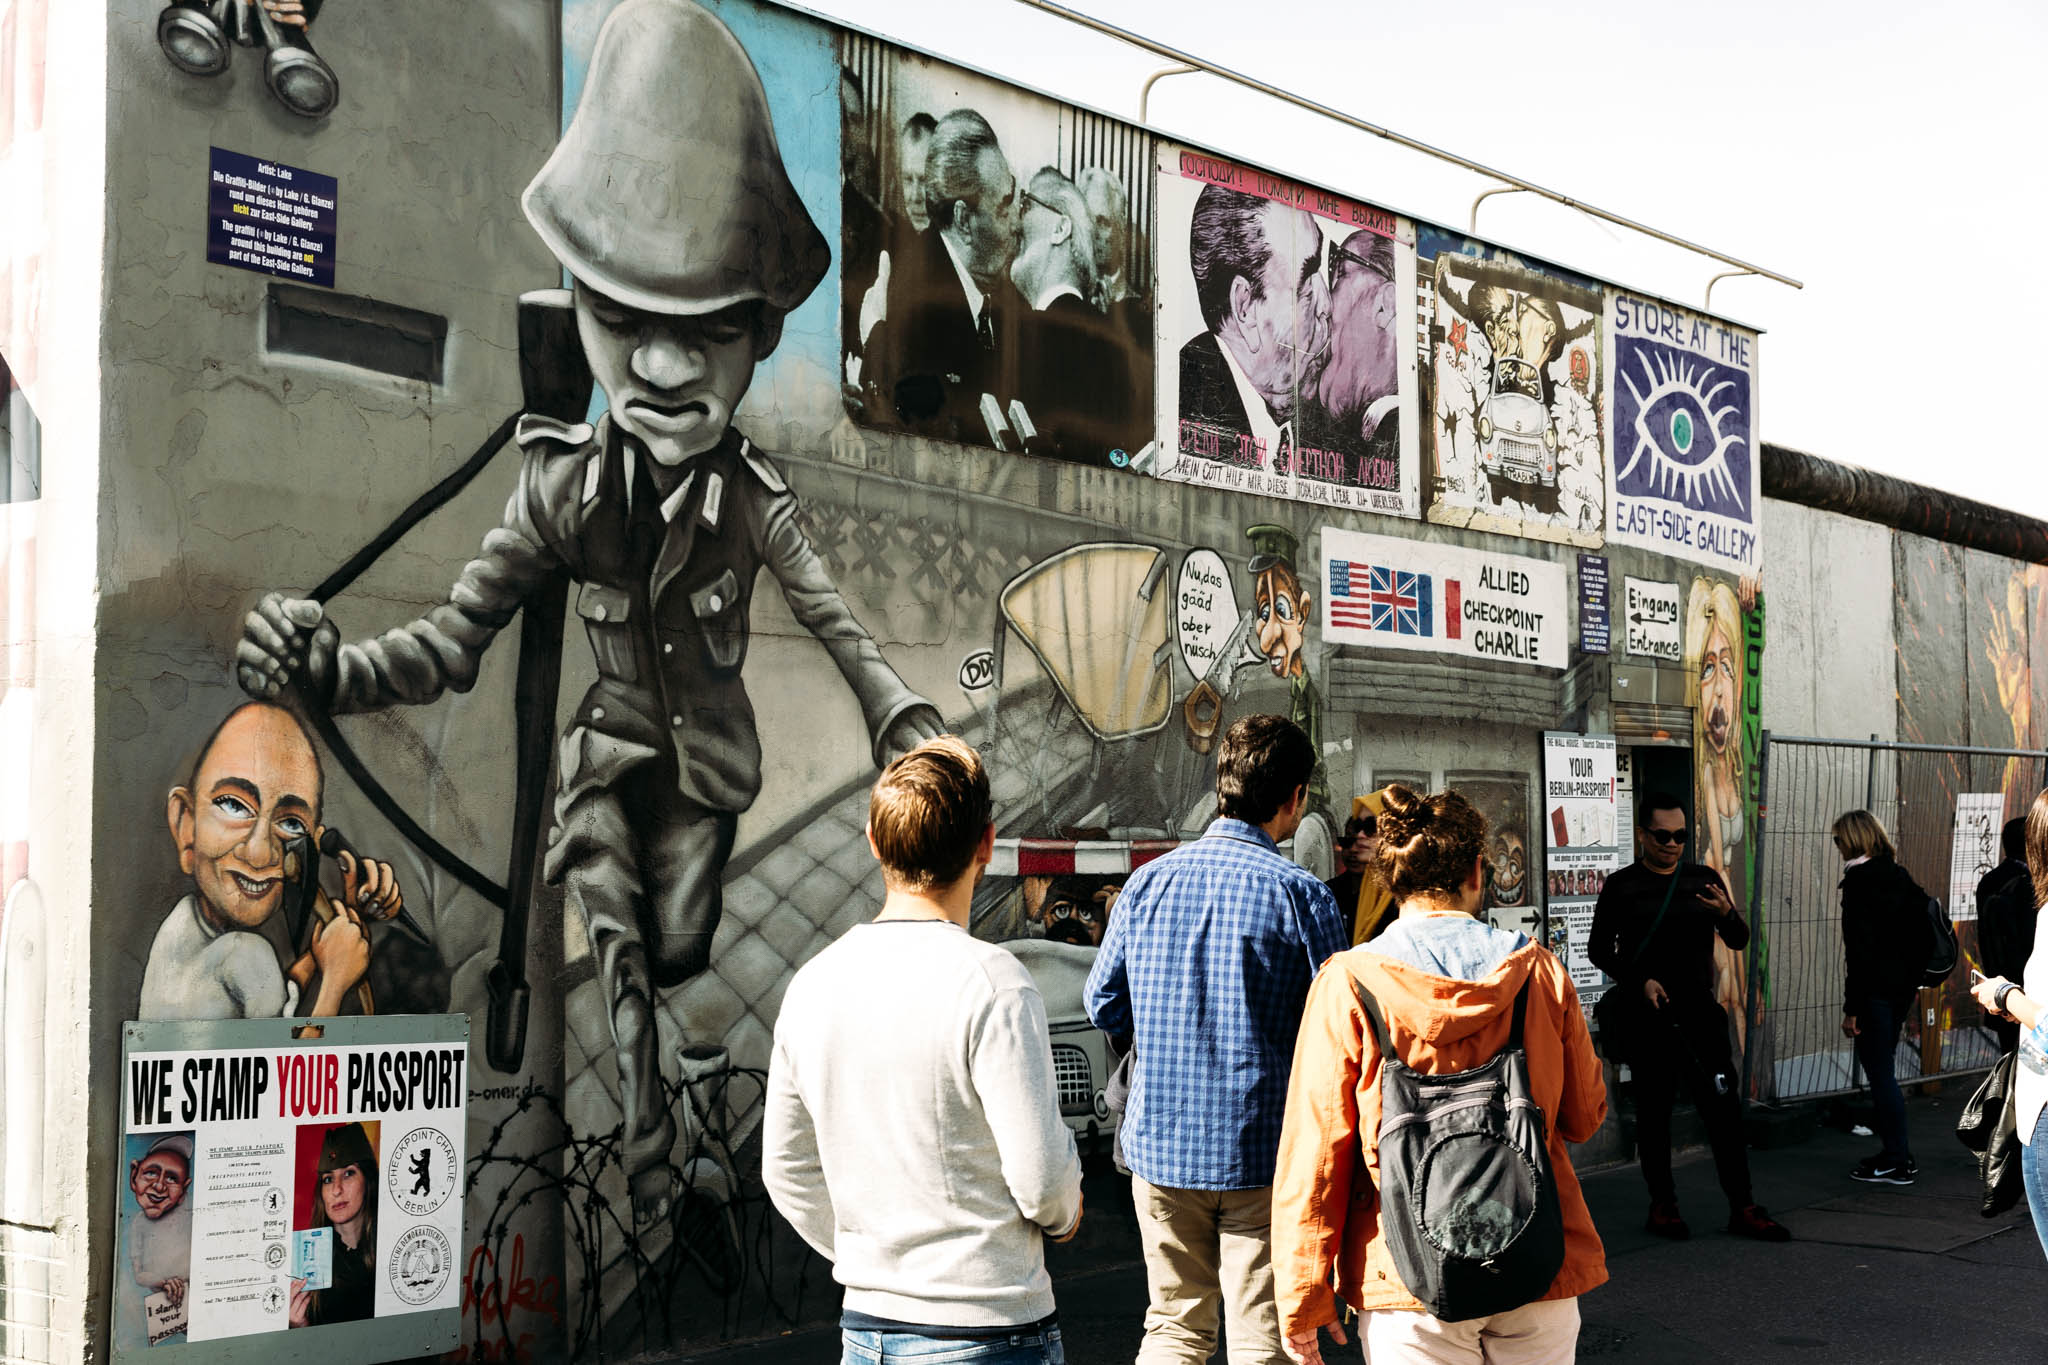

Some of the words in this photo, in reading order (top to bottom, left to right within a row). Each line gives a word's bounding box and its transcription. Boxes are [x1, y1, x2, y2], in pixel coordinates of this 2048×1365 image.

[258, 163, 276, 176] Artist:
[277, 168, 292, 180] Lake
[213, 170, 224, 182] Die
[225, 173, 267, 193] Graffiti-Bilder
[284, 188, 299, 201] Lake
[303, 193, 310, 204] G.
[311, 195, 334, 210] Glanze)
[229, 189, 244, 201] rund
[245, 193, 255, 203] um
[256, 194, 276, 209] dieses
[277, 200, 292, 213] Haus
[293, 203, 318, 219] gehören
[1317, 192, 1340, 216] МНЕ
[233, 203, 249, 215] nicht
[250, 208, 261, 218] zur
[261, 209, 290, 225] East-Side
[291, 216, 314, 232] Gallery.
[222, 219, 233, 232] The
[234, 223, 255, 236] graffiti
[273, 231, 287, 245] Lake
[292, 236, 299, 247] G.
[300, 238, 323, 253] Glanze)
[231, 236, 253, 250] around
[254, 240, 265, 253] this
[266, 243, 292, 259] building
[292, 250, 303, 261] are
[303, 253, 314, 264] not
[229, 250, 242, 260] part
[243, 252, 250, 263] of
[251, 253, 261, 265] the
[261, 254, 291, 272] East-Side
[291, 262, 314, 278] Gallery.
[1615, 295, 1685, 346] STORE
[1690, 318, 1712, 351] AT
[1717, 328, 1750, 368] THE
[1267, 476, 1288, 495] DIESE
[1616, 502, 1693, 546] EAST-SIDE
[1697, 520, 1756, 566] GALLERY
[1479, 565, 1530, 596] ALLIED
[1463, 599, 1544, 633] CHECKPOINT
[1629, 587, 1678, 623] Eingang
[1182, 615, 1211, 635] ober
[1184, 635, 1216, 660] nüsch
[1475, 630, 1539, 661] CHARLIE
[1629, 628, 1679, 657] Entrance
[1569, 757, 1593, 778] YOUR
[132, 1059, 172, 1126] WE
[181, 1056, 269, 1124] STAMP
[276, 1053, 339, 1119] YOUR
[346, 1049, 465, 1115] PASSPORT
[390, 1130, 434, 1186] CHECKPOINT
[435, 1135, 455, 1183] CHARLIE
[403, 1199, 438, 1214] BERLIN
[148, 1306, 152, 1318] I
